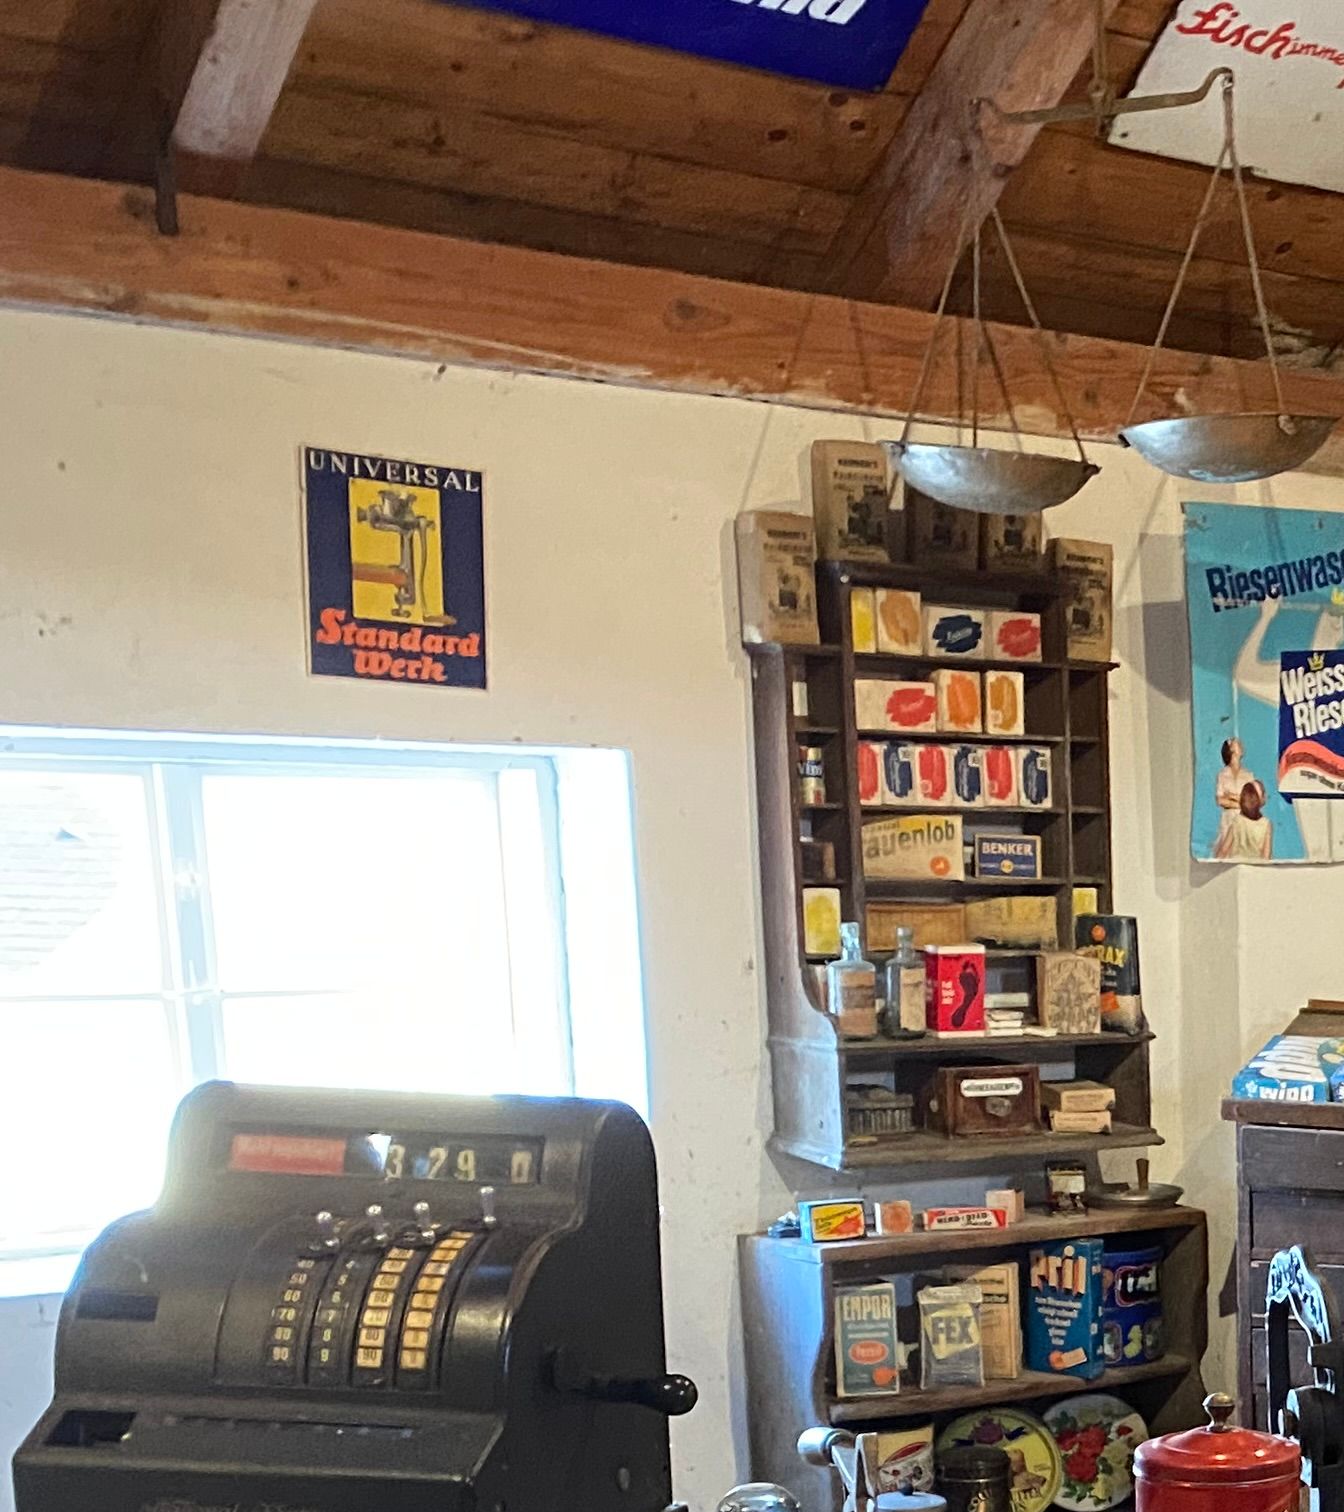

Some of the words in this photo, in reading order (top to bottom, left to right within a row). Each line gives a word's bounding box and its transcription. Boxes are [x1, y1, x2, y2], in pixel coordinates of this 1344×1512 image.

[309, 450, 480, 493] UNIVERSAL
[316, 607, 481, 658] Standard
[353, 648, 447, 682] Werk
[982, 841, 1034, 857] BENKER
